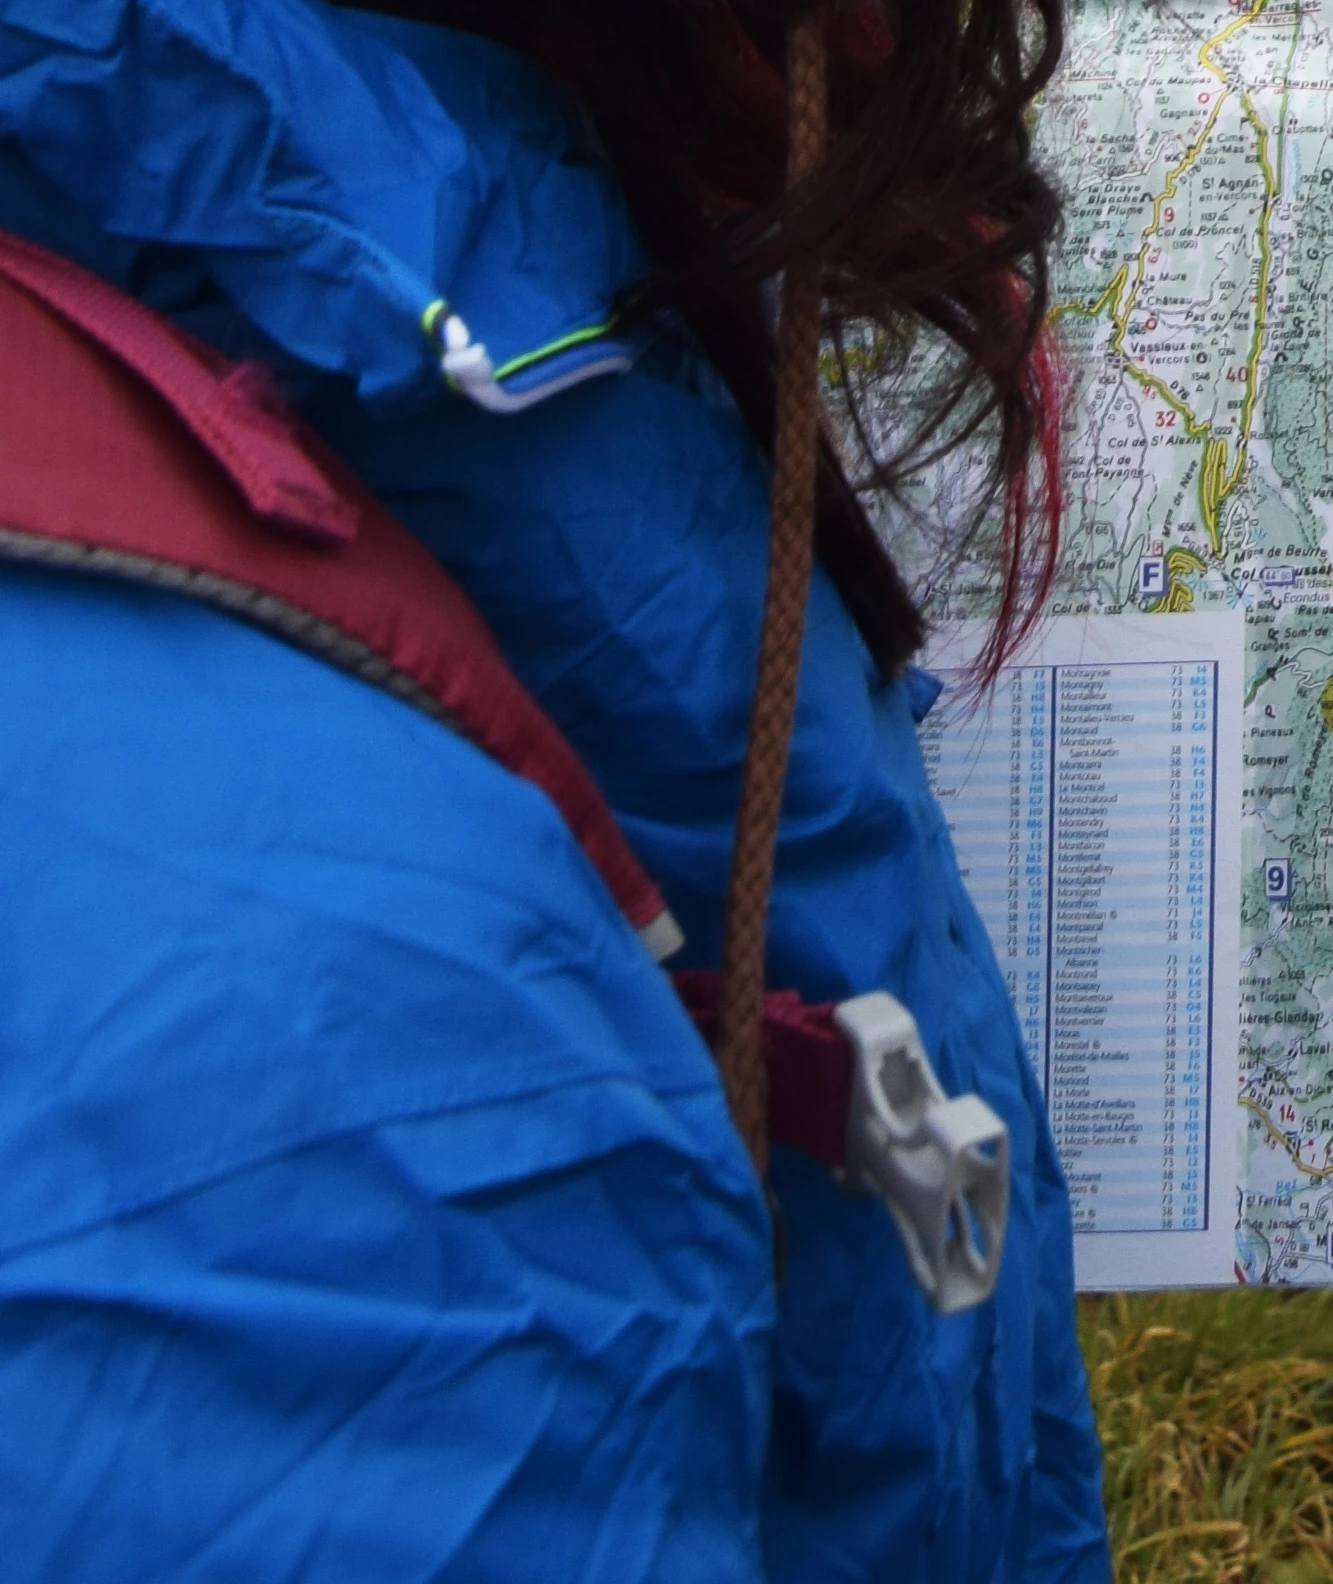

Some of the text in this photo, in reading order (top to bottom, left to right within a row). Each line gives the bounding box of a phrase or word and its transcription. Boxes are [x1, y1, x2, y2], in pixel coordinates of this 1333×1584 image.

[1226, 368, 1248, 383] 40
[1156, 411, 1176, 427] 32
[1143, 561, 1161, 587] F
[1269, 866, 1284, 889] 9
[1279, 1105, 1295, 1122] 14
